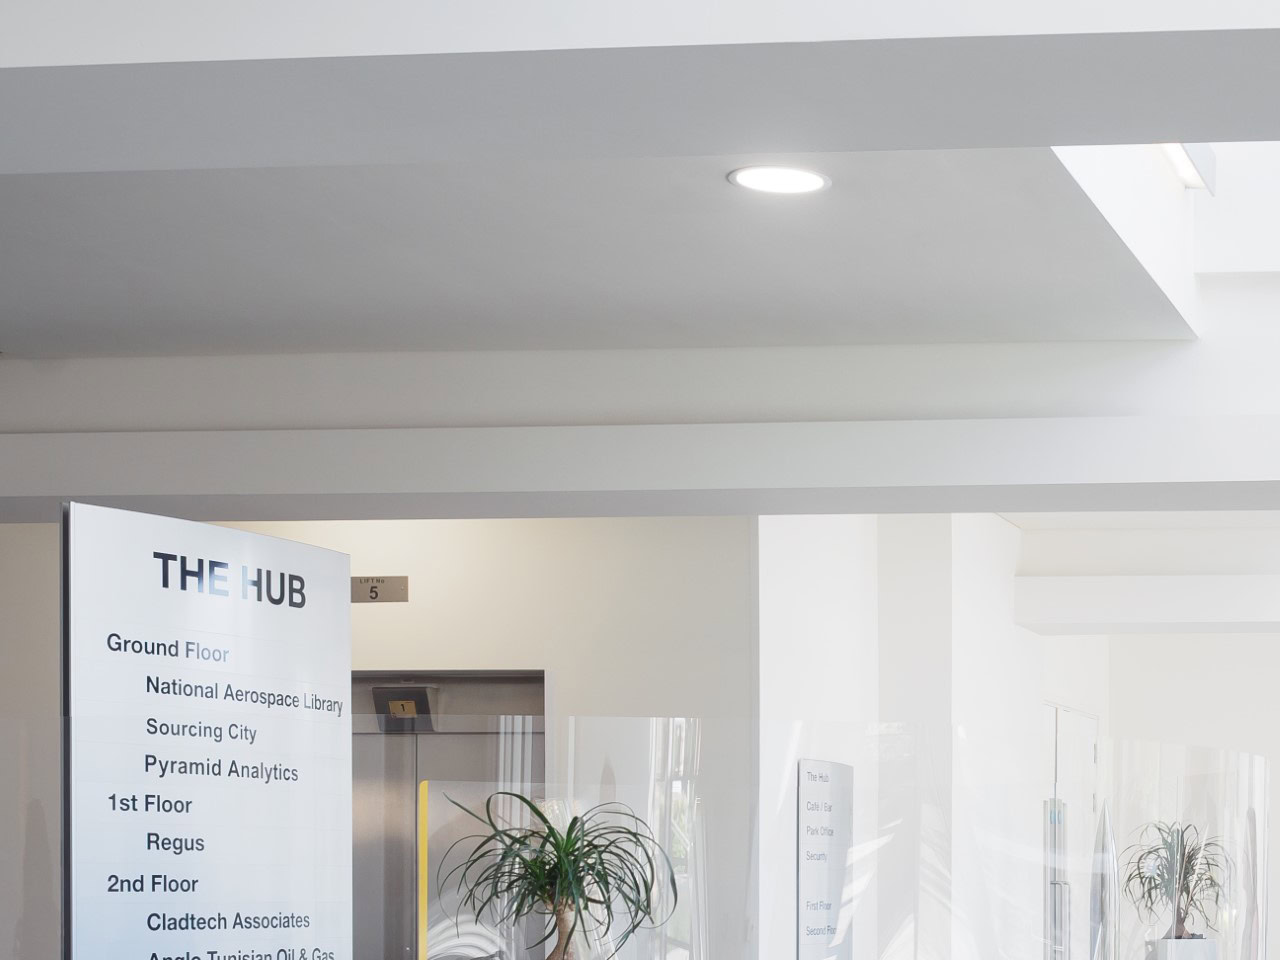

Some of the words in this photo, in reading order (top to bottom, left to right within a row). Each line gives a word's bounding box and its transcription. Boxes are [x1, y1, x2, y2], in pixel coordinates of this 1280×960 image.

[152, 551, 230, 598] THE
[241, 565, 307, 609] HUB
[369, 585, 379, 600] 5
[106, 633, 180, 658] Ground
[185, 641, 230, 663] Floor
[145, 675, 219, 700] National
[223, 683, 300, 710] Aerospace
[303, 693, 344, 718] Library
[145, 718, 223, 743] Sourcing
[227, 723, 257, 745] City
[144, 754, 222, 778] Pyramid
[227, 759, 299, 782] Analytics
[107, 794, 139, 812] 1st
[144, 795, 193, 814] Floor
[146, 832, 205, 855] Regus
[107, 874, 145, 893] 2nd
[151, 874, 199, 893] Floor
[146, 912, 228, 931] Cladtech
[232, 911, 311, 930] Associates
